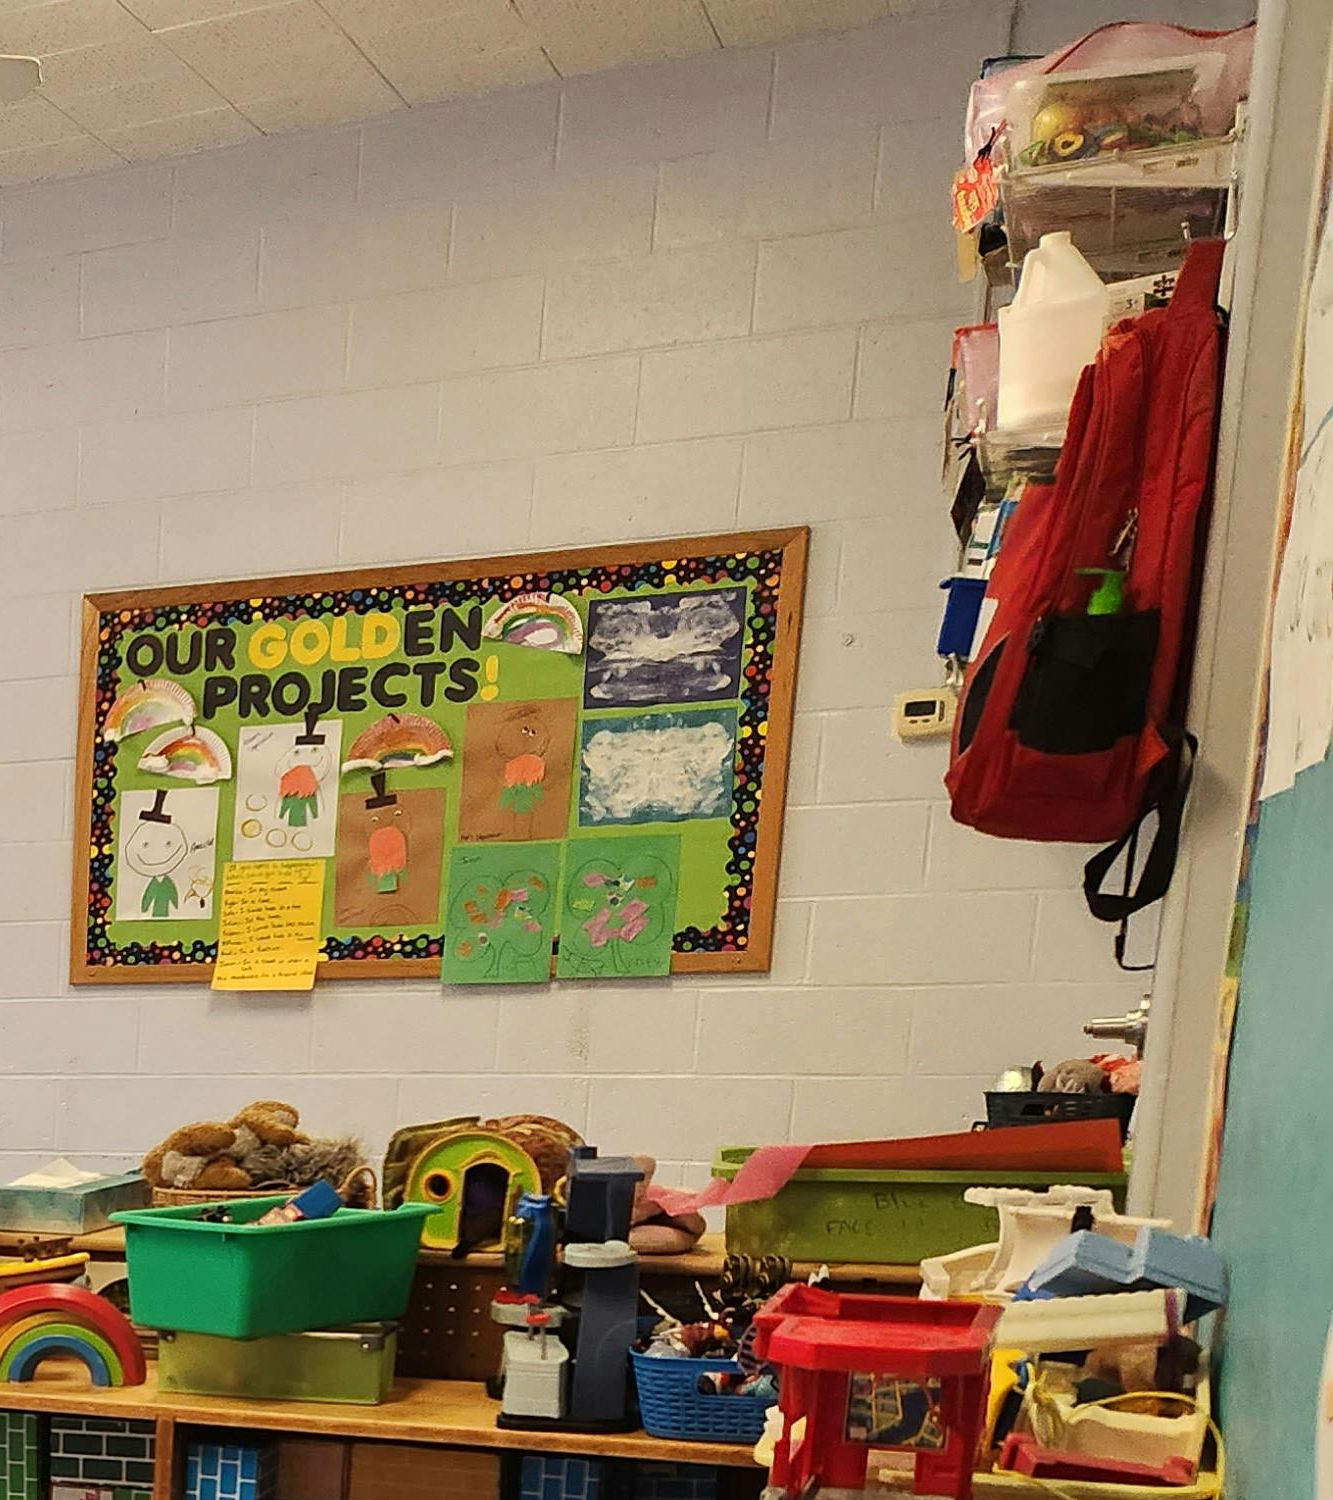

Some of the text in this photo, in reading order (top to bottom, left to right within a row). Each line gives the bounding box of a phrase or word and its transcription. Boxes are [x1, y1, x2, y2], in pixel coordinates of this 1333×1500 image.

[123, 605, 484, 677] OUR GOLDEN
[202, 656, 501, 719] PROJECTS!
